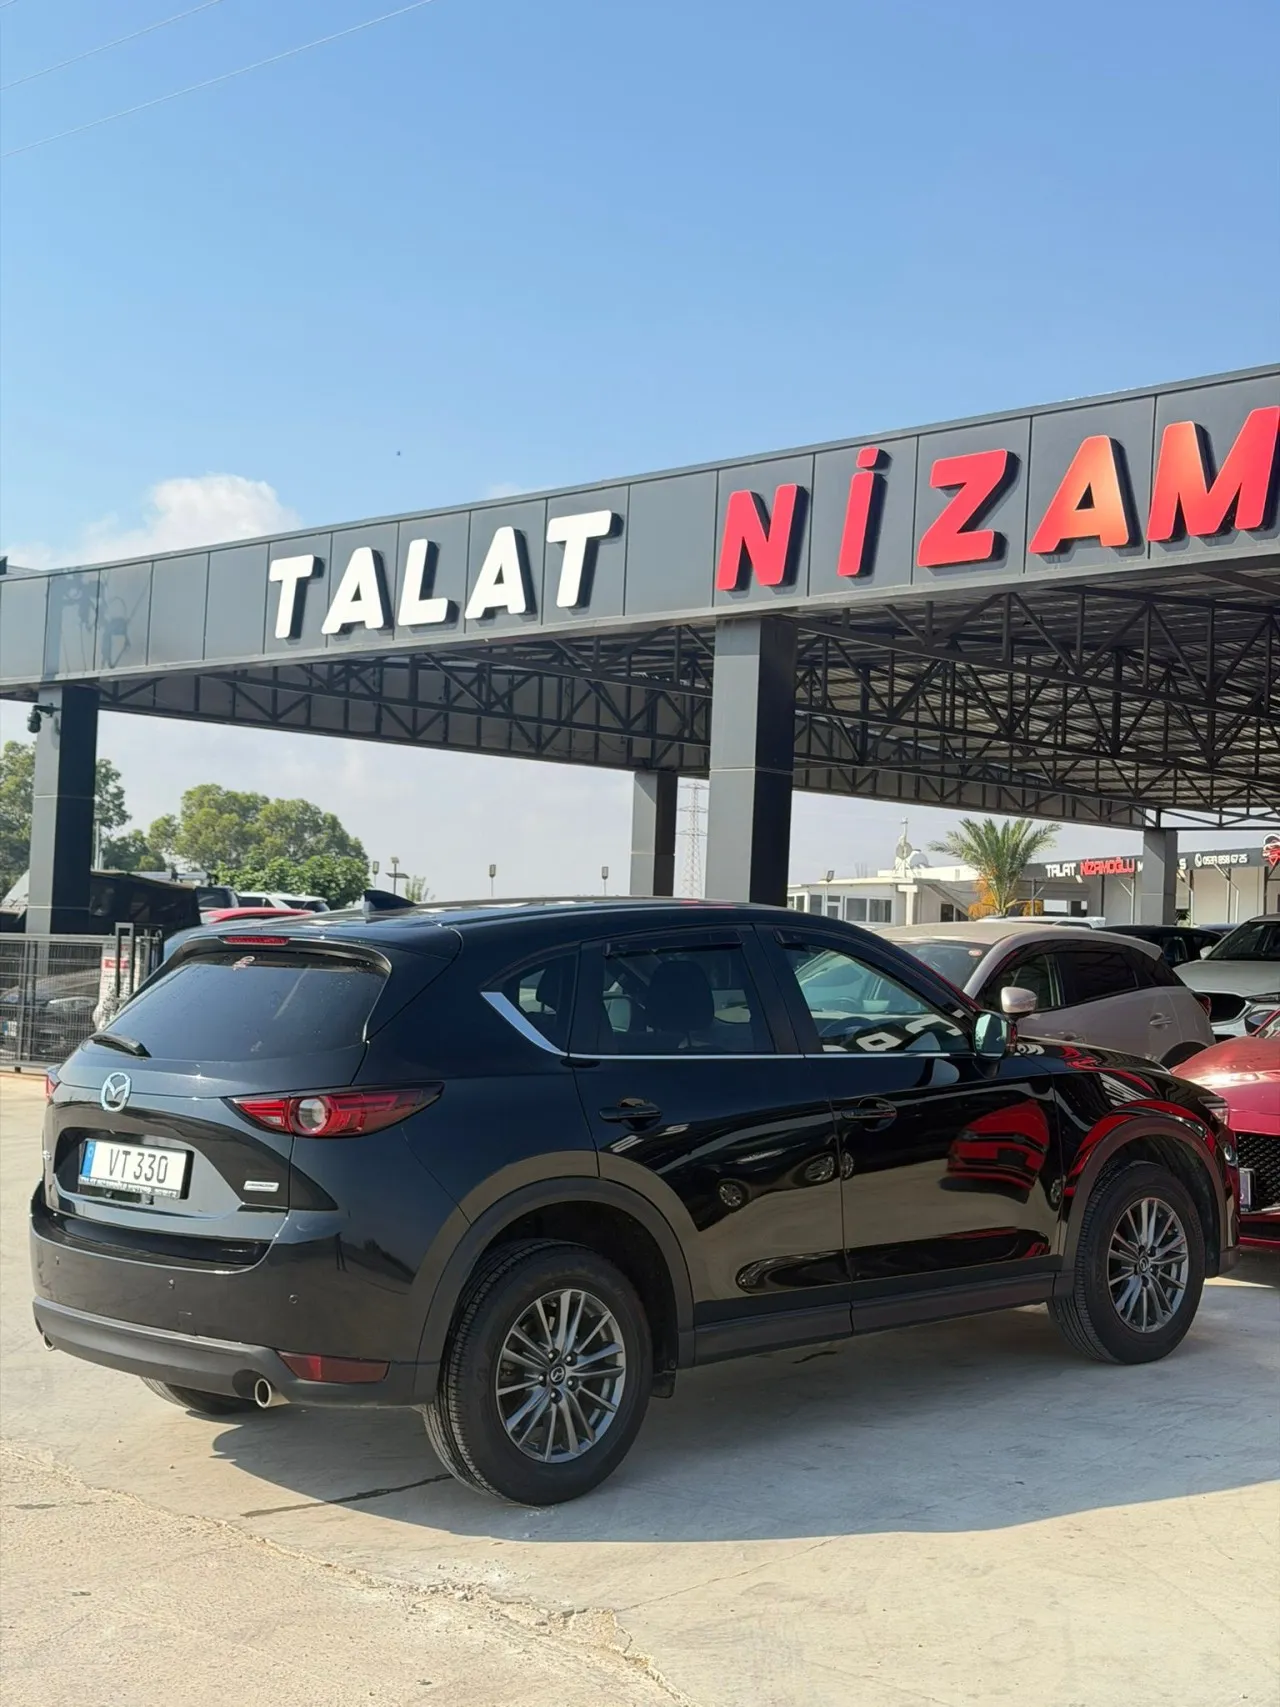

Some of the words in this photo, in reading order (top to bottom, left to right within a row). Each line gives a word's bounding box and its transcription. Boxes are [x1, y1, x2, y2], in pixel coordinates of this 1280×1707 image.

[269, 510, 612, 639] TALAT
[1045, 863, 1076, 877] TALAT
[1080, 857, 1134, 875] NİZAMOĞLU
[109, 1148, 131, 1178] VT
[133, 1152, 168, 1184] 330
